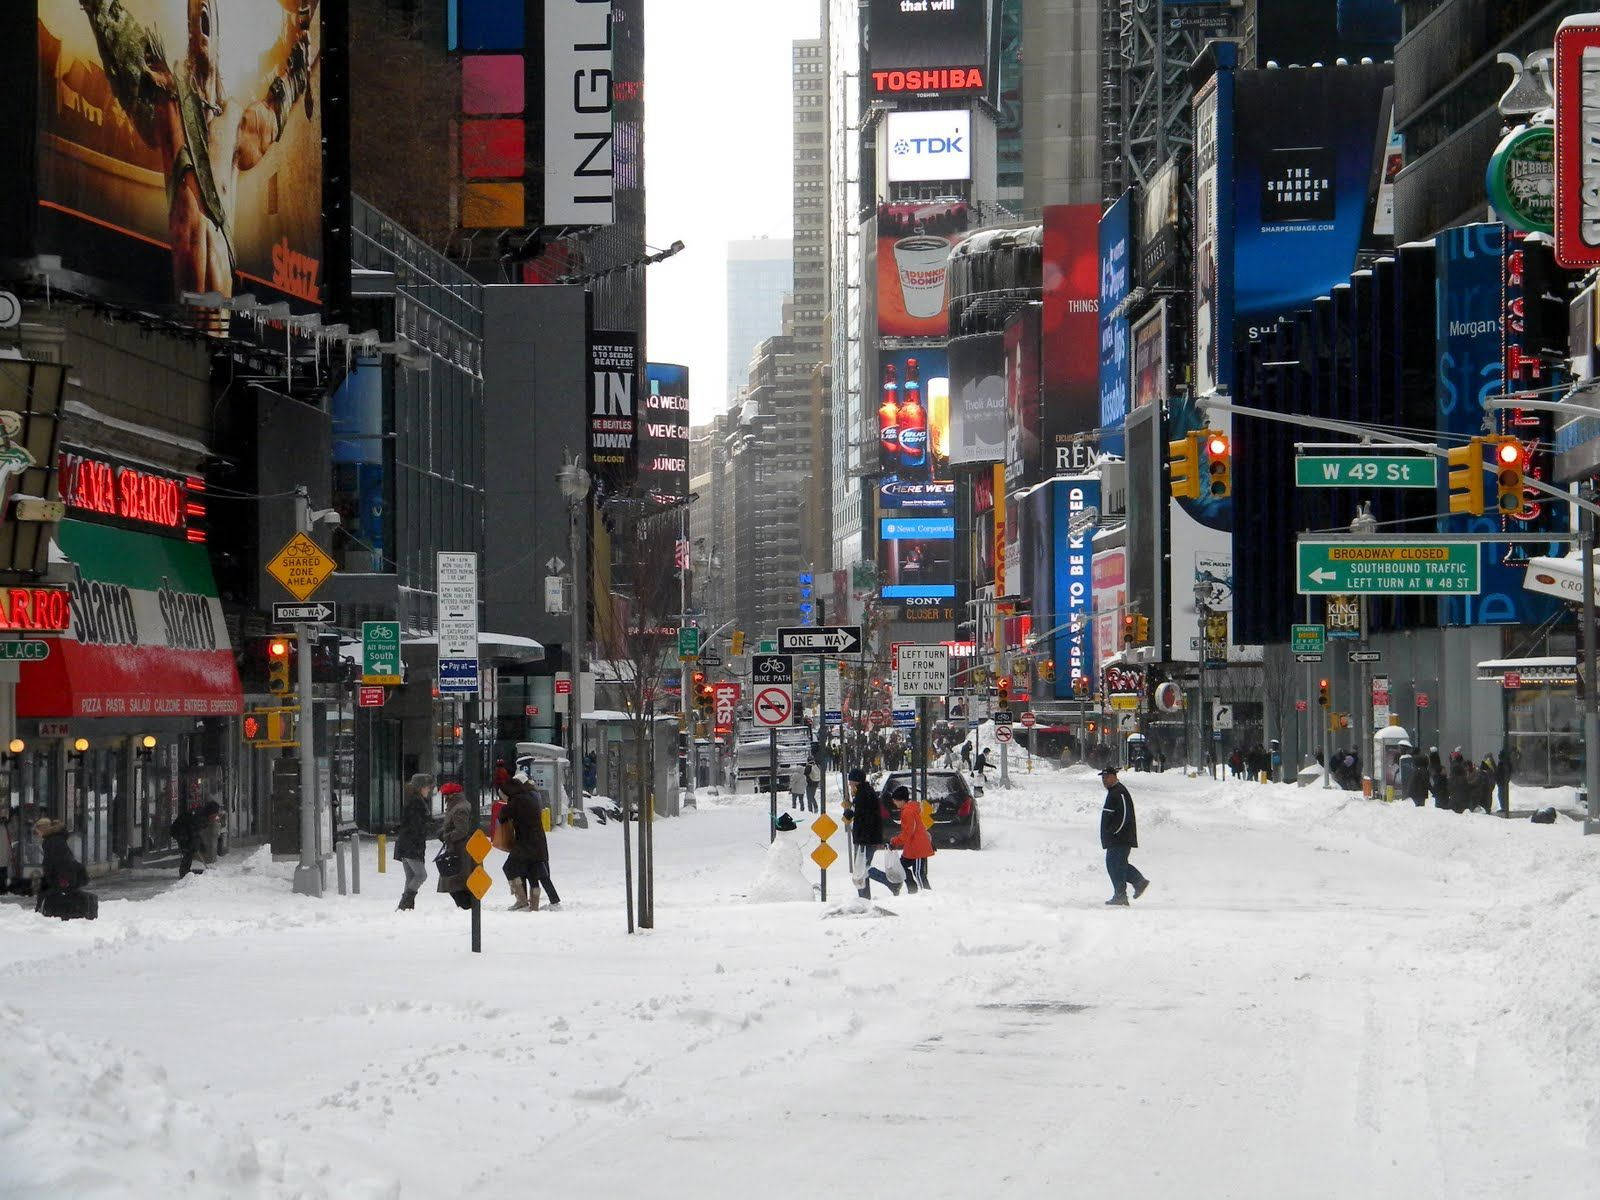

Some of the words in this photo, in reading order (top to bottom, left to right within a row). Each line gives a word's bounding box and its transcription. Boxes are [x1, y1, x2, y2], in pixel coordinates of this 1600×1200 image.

[900, 0, 927, 12] that
[932, 0, 954, 10] will
[872, 69, 983, 91] TOSHIBA
[574, 0, 613, 203] INGL
[910, 136, 963, 153] TDK
[1287, 168, 1310, 178] THE
[1267, 180, 1329, 190] SHARPER
[1277, 191, 1320, 202] IMAGE
[1261, 224, 1335, 233] SHARPERIMAGE.COM
[1068, 300, 1099, 313] THINGS
[1450, 320, 1496, 337] Morgan
[594, 358, 634, 366] BEATLES!
[602, 420, 632, 430] BEATLES
[648, 424, 677, 438] VIEVE
[1322, 463, 1340, 480] W
[1348, 463, 1378, 480] 49
[1386, 463, 1410, 481] St
[892, 485, 923, 493] HERE
[119, 466, 185, 529] SBARRO
[1069, 487, 1084, 549] KED
[897, 525, 915, 533] News
[1333, 549, 1395, 559] BROADWAY
[1400, 548, 1444, 559] CLOSED
[282, 558, 320, 567] SHARED
[1069, 555, 1084, 576] BE
[289, 567, 314, 576] ZONE
[1350, 563, 1420, 574] SOUTHBOUND
[1426, 563, 1466, 573] TRAFFIC
[287, 577, 319, 586] AHEAD
[1347, 578, 1372, 588] LEFT
[1377, 578, 1405, 588] TURN
[1409, 578, 1420, 588] AT
[1426, 578, 1434, 588] W
[1439, 578, 1453, 588] 48
[1456, 578, 1470, 588] ST
[1069, 581, 1084, 607] TO
[66, 562, 140, 646] sbarro
[906, 597, 942, 605] SONY
[158, 575, 217, 652] sbarro
[282, 608, 301, 617] ONE
[307, 608, 326, 617] WAY
[906, 608, 939, 619] CLOSER
[1328, 603, 1358, 613] KING
[1328, 613, 1357, 626] TUT
[790, 636, 813, 646] ONE
[824, 635, 848, 646] WAY
[902, 651, 921, 659] LEFT
[925, 651, 945, 659] TURN
[448, 663, 459, 671] Pay
[913, 661, 934, 669] FROM
[902, 672, 921, 680] LEFT
[925, 672, 945, 680] TURN
[904, 682, 919, 690] BAY
[923, 682, 943, 690] ONLY
[81, 699, 102, 712] PIZZA
[105, 699, 126, 712] PASTA
[129, 699, 151, 712] SALAD
[154, 699, 181, 712] CALZONE
[184, 699, 208, 712] ENTREES
[209, 699, 238, 712] ESPRESSO
[717, 687, 734, 724] tkts
[41, 723, 69, 735] ATM
